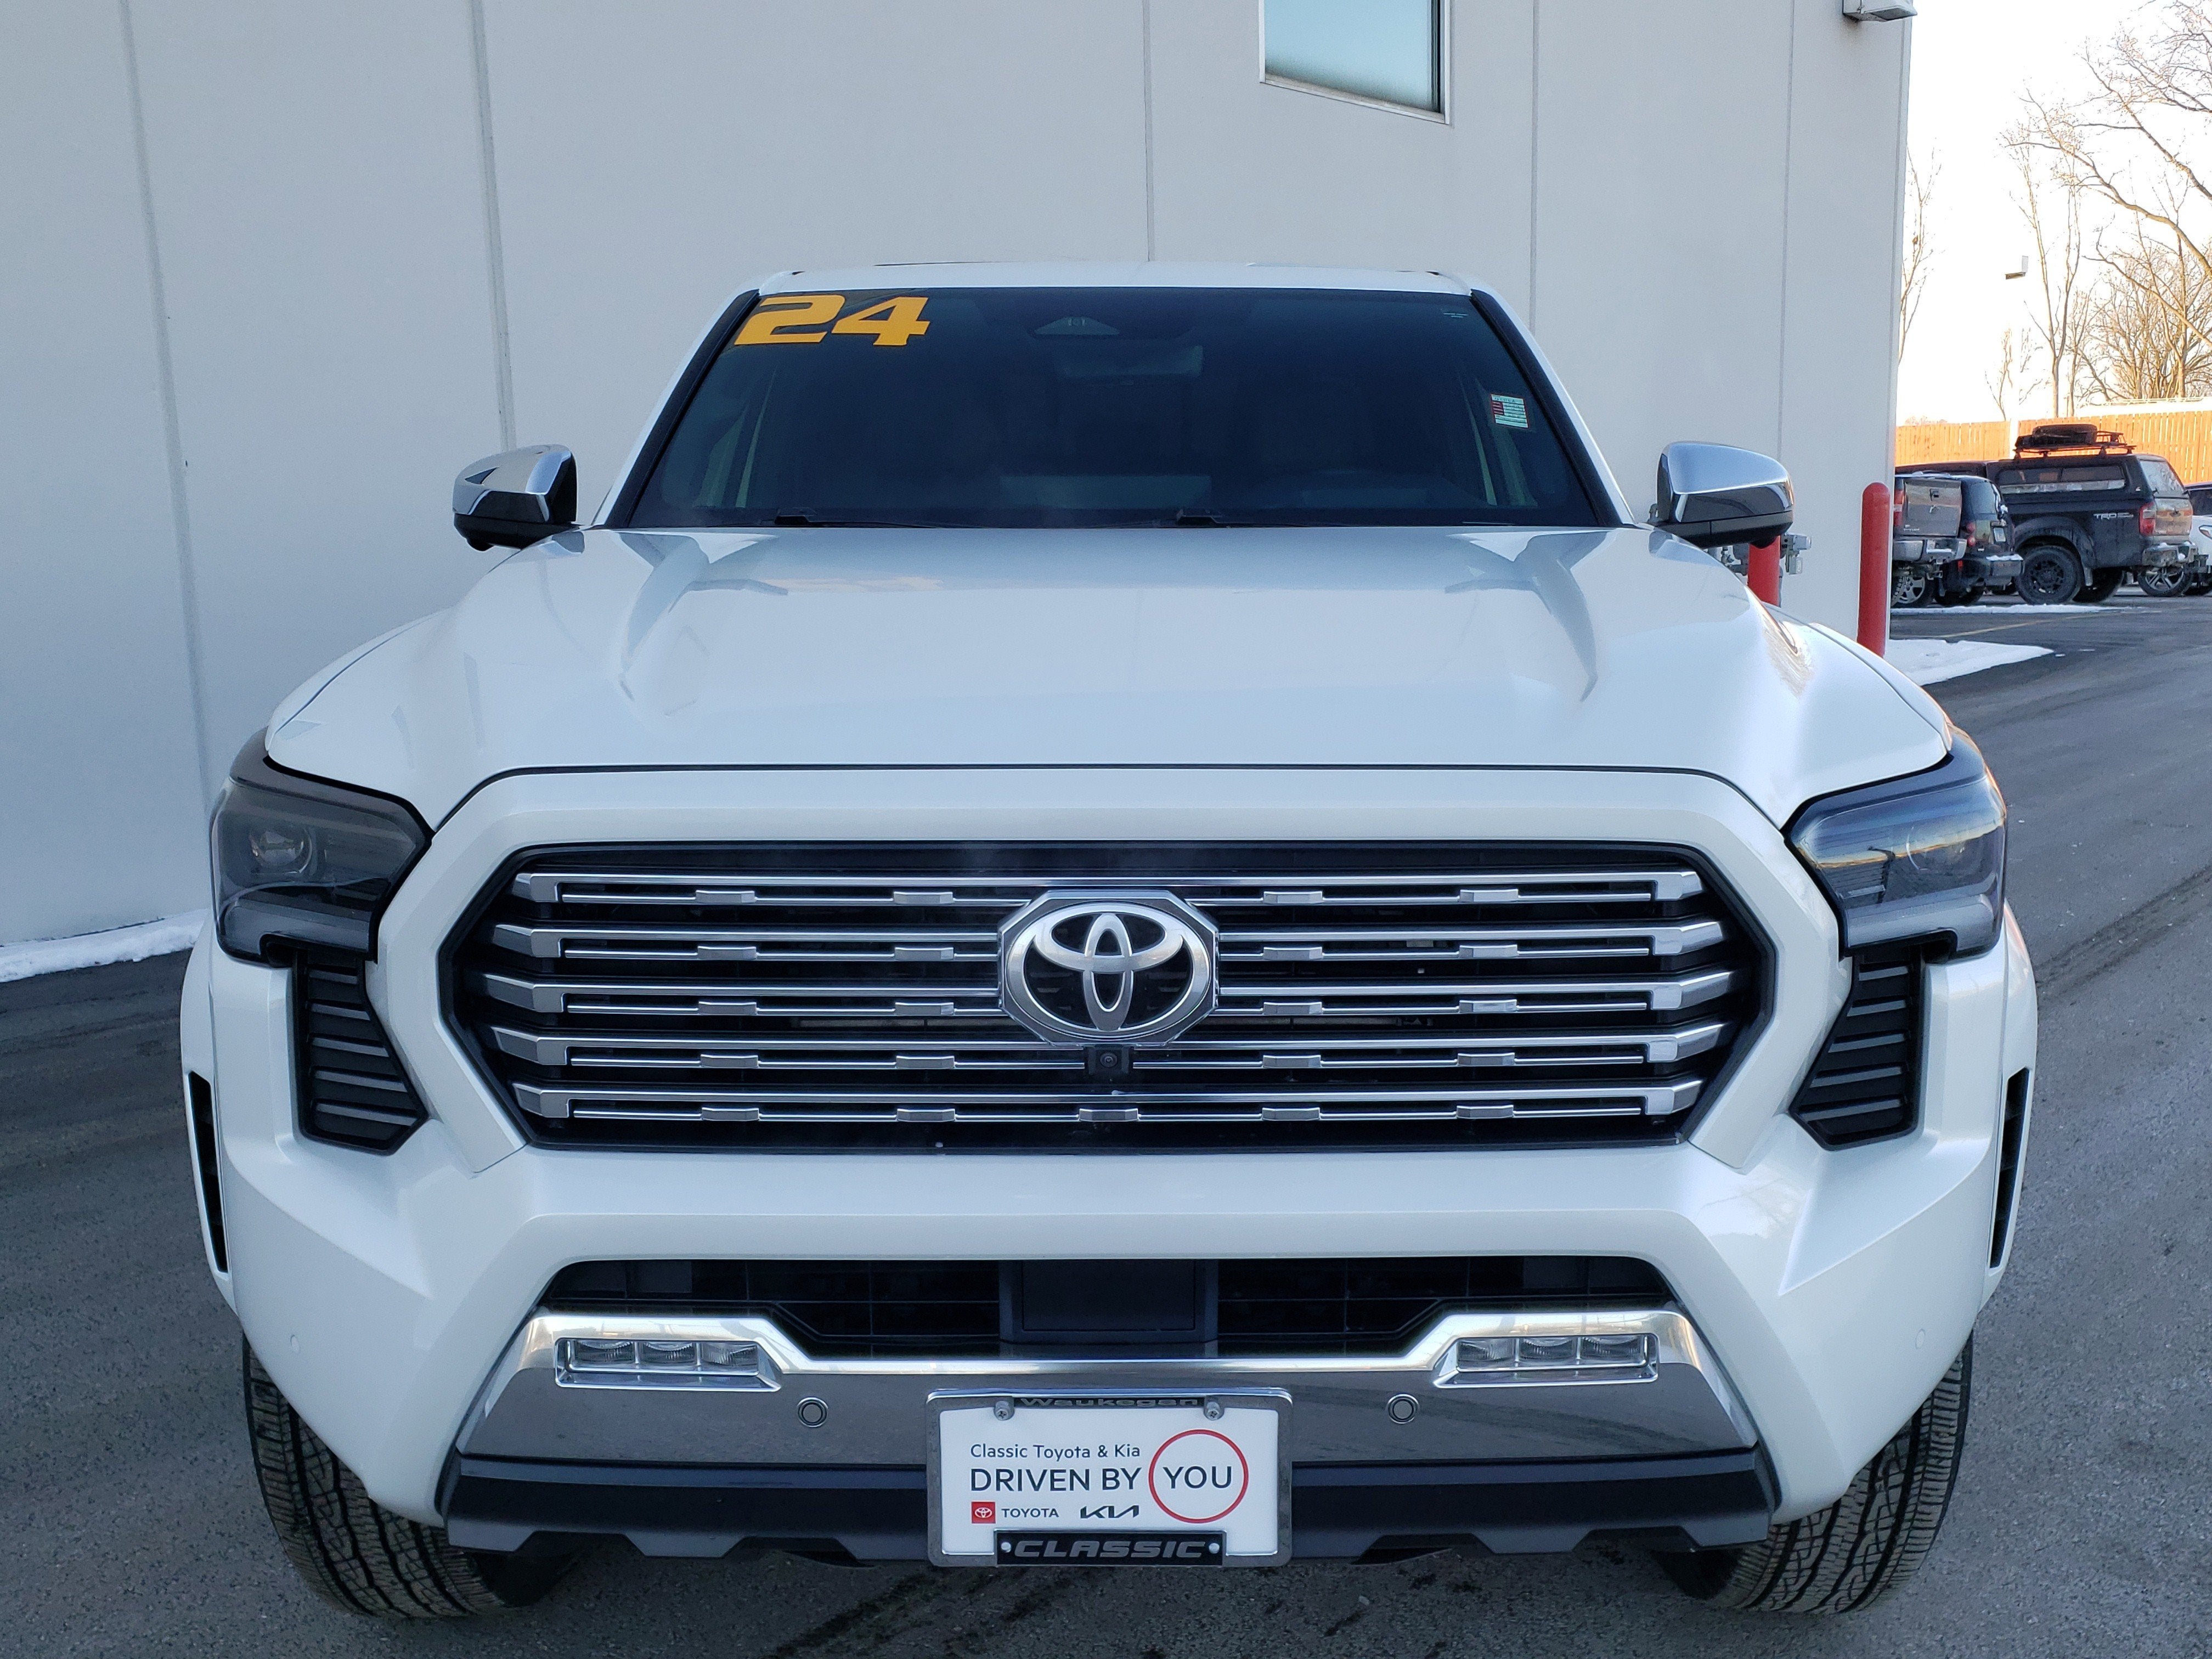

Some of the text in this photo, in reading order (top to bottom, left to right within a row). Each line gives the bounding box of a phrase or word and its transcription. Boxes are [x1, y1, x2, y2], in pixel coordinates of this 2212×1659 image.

[733, 295, 930, 346] 24
[970, 1443, 1141, 1462] Classic Toyota & Kia
[970, 1465, 1232, 1491] DRIVEN BY YOU
[1002, 1508, 1059, 1518] TOYOTA
[1014, 1541, 1206, 1558] CLASSIC
